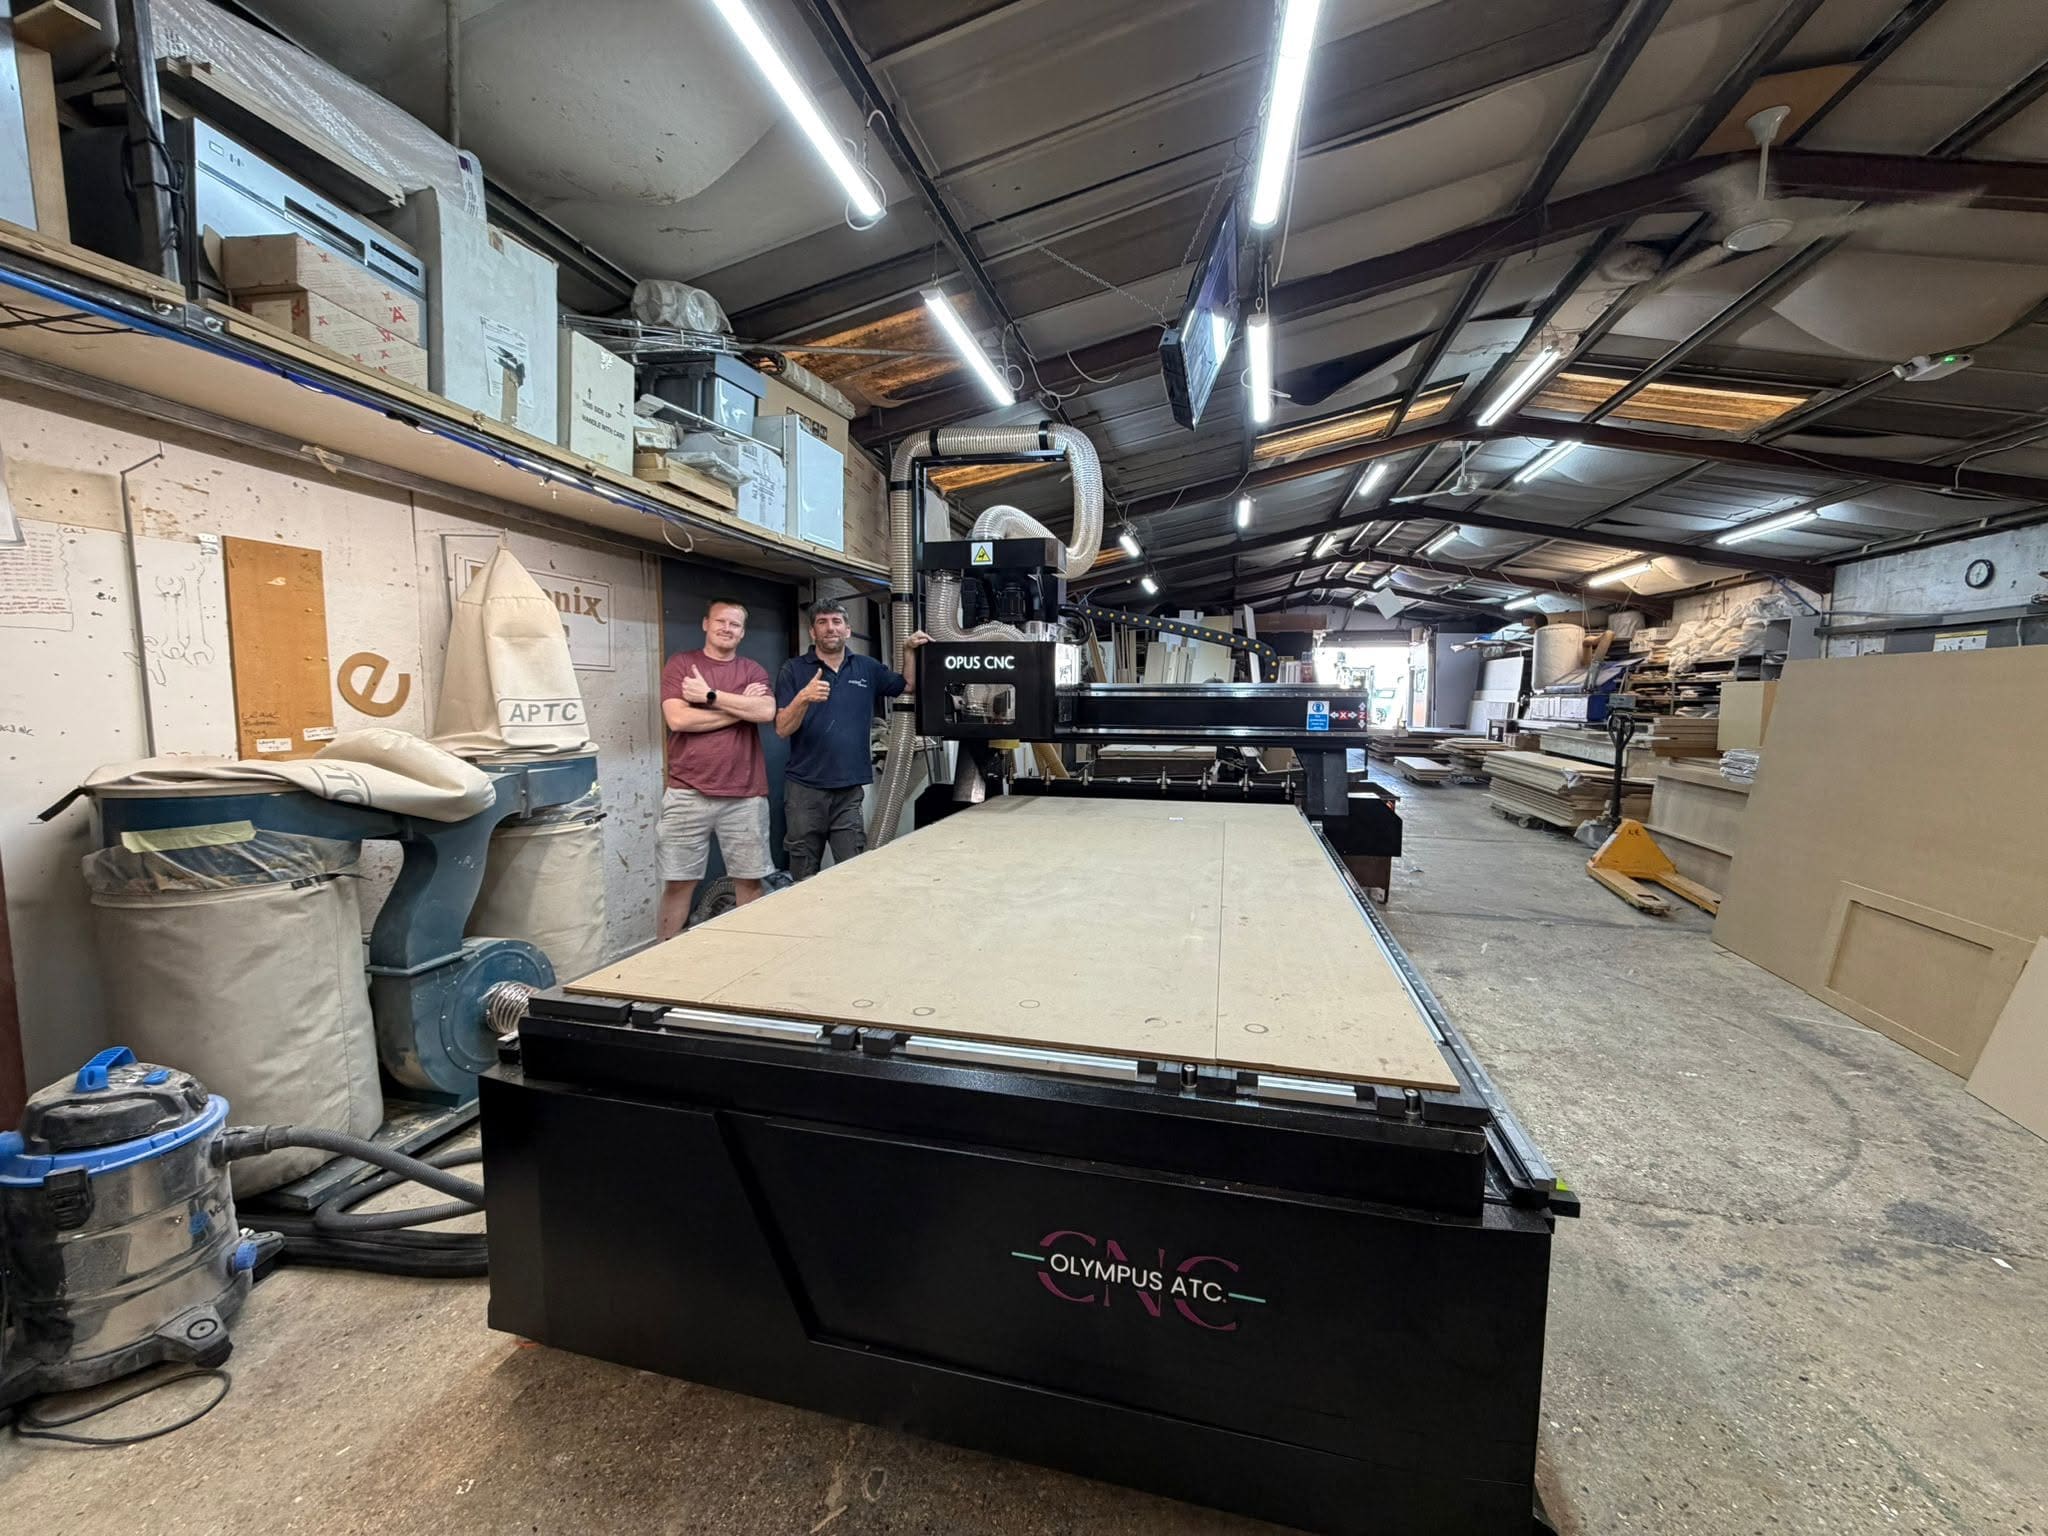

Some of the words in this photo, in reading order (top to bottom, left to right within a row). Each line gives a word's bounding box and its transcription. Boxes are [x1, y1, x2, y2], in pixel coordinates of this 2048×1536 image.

[582, 399, 593, 410] THIS
[594, 405, 605, 416] SIDE
[581, 413, 602, 429] HANDLE
[944, 655, 981, 669] OPUS
[984, 655, 1015, 669] CNC
[509, 703, 578, 722] APTC
[1050, 1253, 1163, 1291] OLYMPUS
